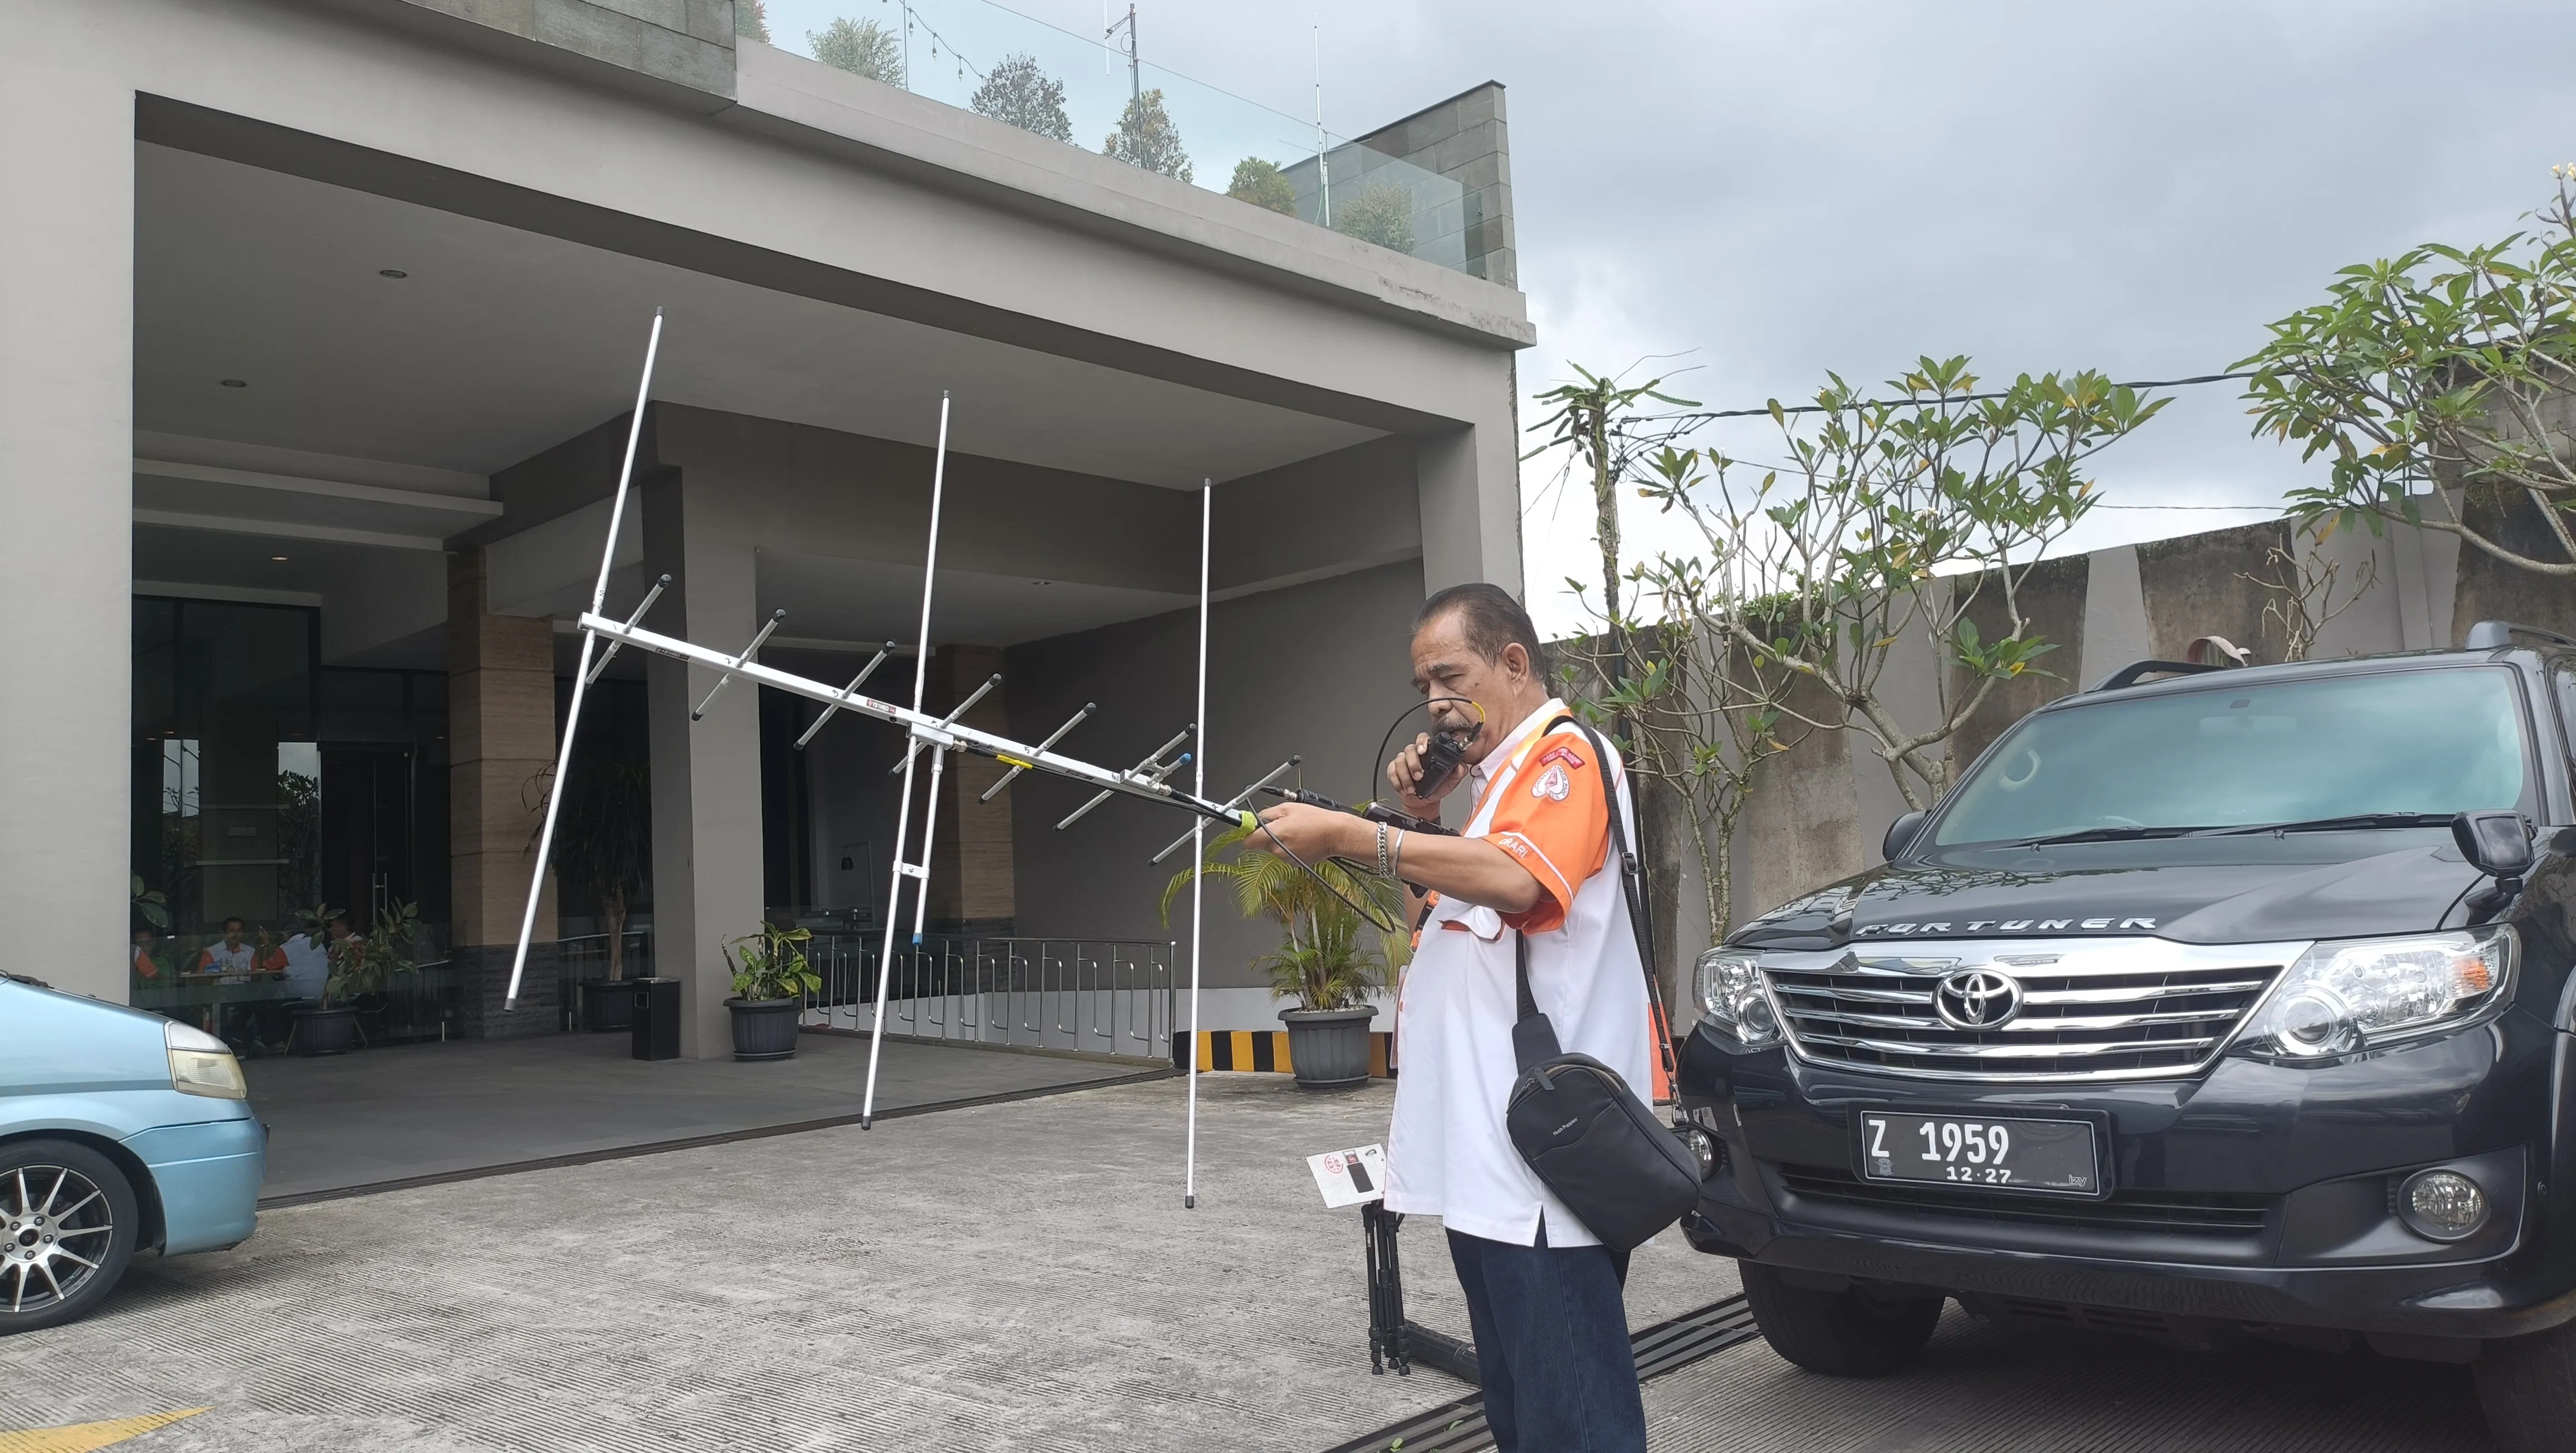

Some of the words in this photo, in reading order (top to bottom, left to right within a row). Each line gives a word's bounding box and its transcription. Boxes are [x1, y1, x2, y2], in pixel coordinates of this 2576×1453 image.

[832, 689, 839, 698] 3
[1024, 746, 1030, 754] 5
[1856, 918, 2157, 937] FORTUNER
[1552, 1127, 1564, 1136] Hush
[1562, 1116, 1578, 1130] Puppies
[1868, 1119, 1890, 1158] Z
[1919, 1122, 2009, 1165] 1959
[2068, 1174, 2088, 1188] izy
